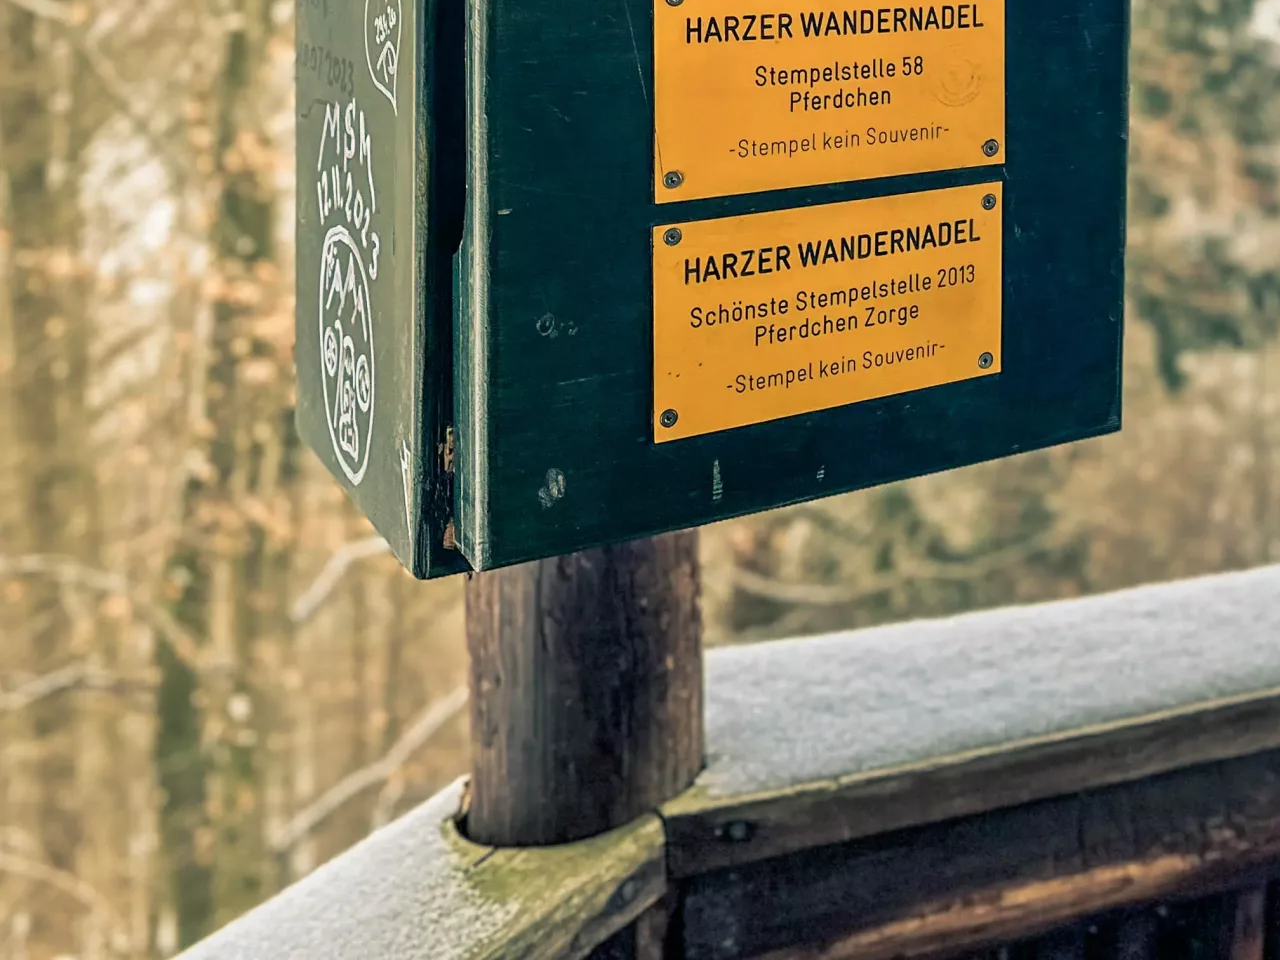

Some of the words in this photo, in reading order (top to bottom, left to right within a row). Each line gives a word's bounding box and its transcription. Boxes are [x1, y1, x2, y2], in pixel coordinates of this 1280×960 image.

[685, 12, 794, 44] HARZER
[799, 3, 985, 38] WANDERNADEL
[754, 57, 897, 88] Stempelstelle
[901, 55, 924, 77] 58
[789, 87, 892, 113] Pferdchen
[728, 133, 817, 159] -Stempel
[822, 129, 861, 150] kein
[866, 121, 950, 146] Souvenir-
[683, 244, 792, 286] HARZER
[797, 217, 982, 268] WANDERNADEL
[689, 297, 790, 329] Schönste
[795, 272, 932, 312] Stempelstelle
[936, 263, 976, 289] 2013
[754, 313, 859, 347] Pferdchen
[863, 303, 920, 328] Zorge
[726, 362, 814, 394] -Stempel
[818, 355, 857, 378] kein
[861, 339, 946, 370] Souvenir-
